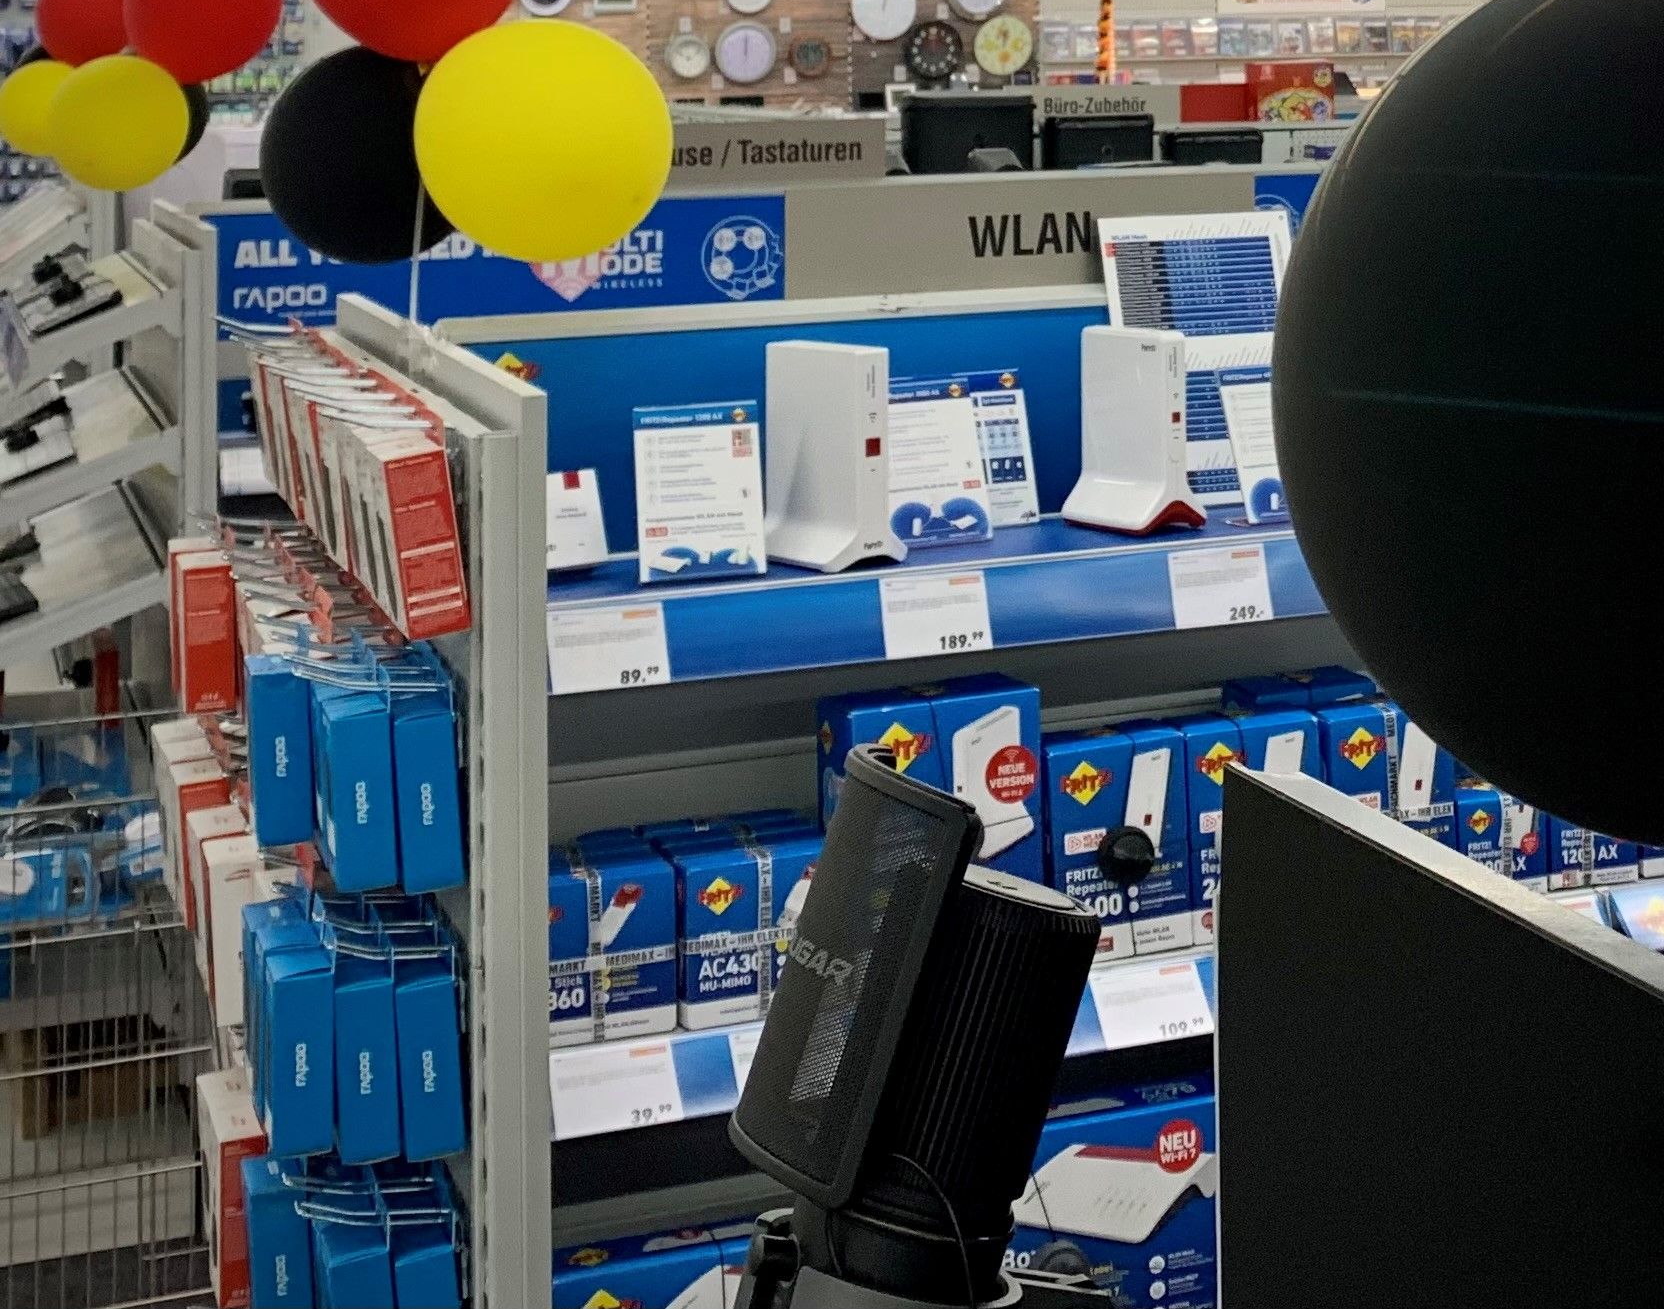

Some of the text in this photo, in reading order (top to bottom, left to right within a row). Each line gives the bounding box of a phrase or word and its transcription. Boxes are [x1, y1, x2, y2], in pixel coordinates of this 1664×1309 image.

[1044, 95, 1147, 117] Büro-Zubehör
[671, 138, 862, 168] use / Tastaturen
[968, 210, 1092, 258] WLAN
[234, 240, 298, 269] ALL
[233, 283, 328, 313] rapoo
[939, 631, 984, 651] 189.99
[620, 665, 660, 686] 89.99
[996, 762, 1027, 776] NEUE
[989, 773, 1036, 789] VERSION
[1598, 843, 1619, 862] AX
[700, 975, 752, 993] MU-MIMO
[1159, 1128, 1197, 1153] NEU
